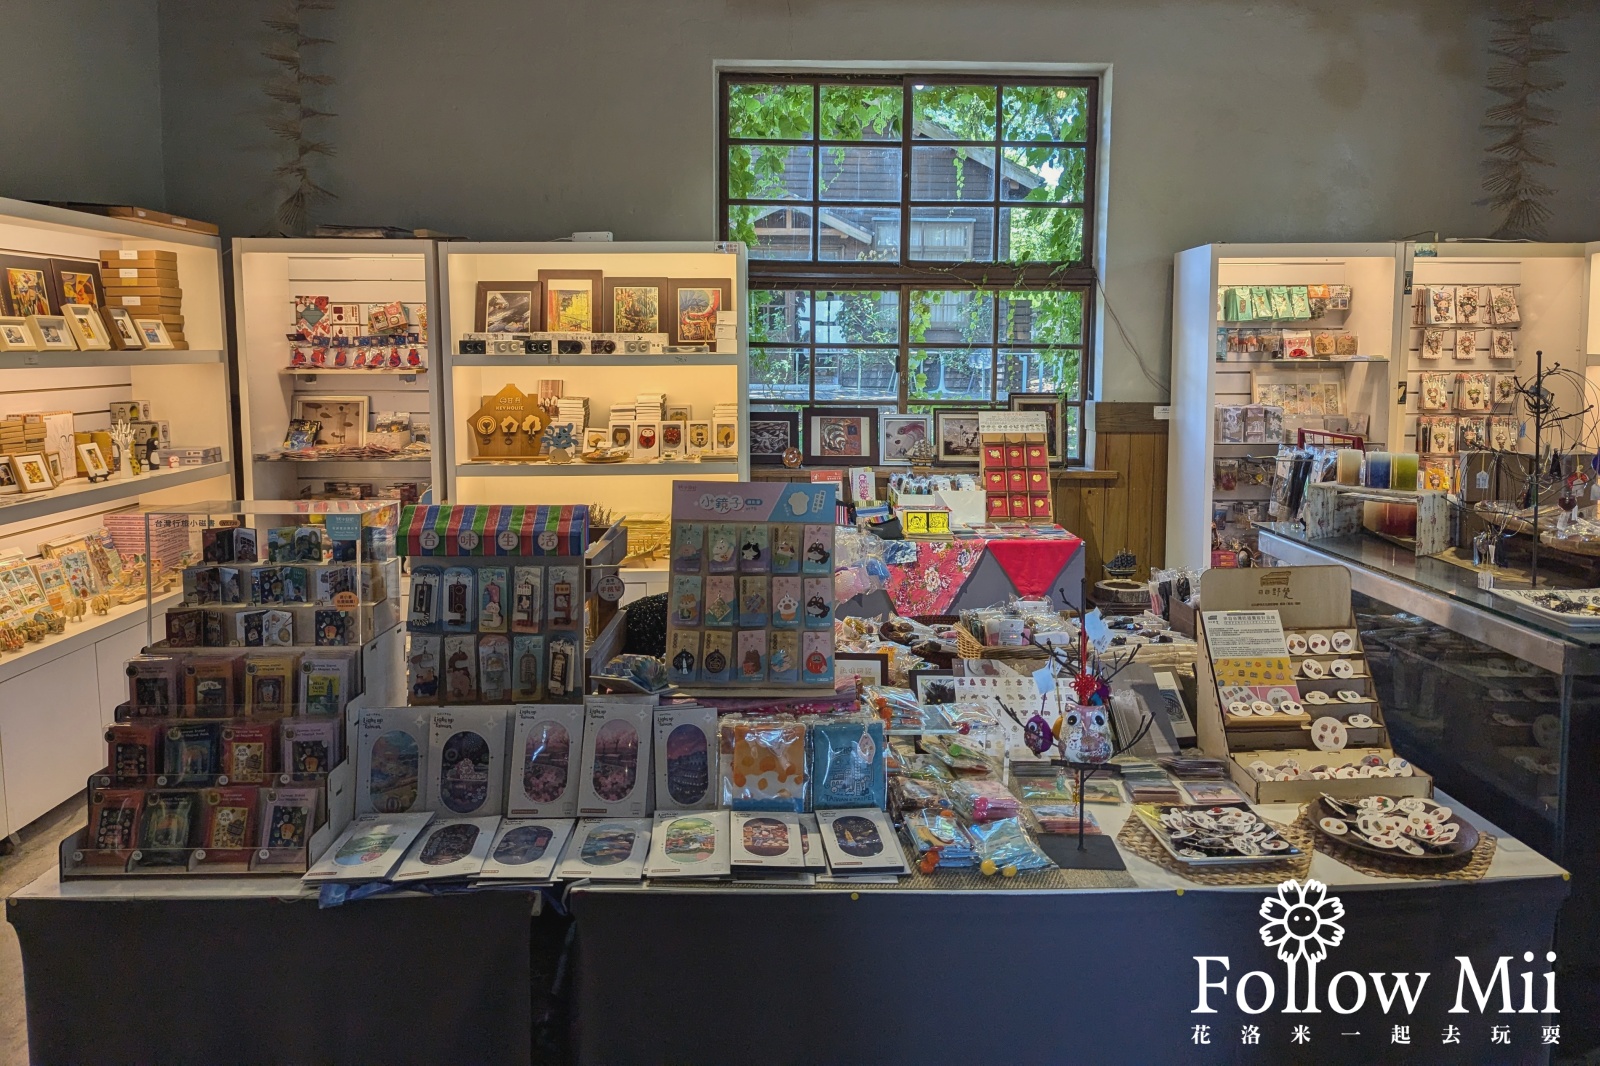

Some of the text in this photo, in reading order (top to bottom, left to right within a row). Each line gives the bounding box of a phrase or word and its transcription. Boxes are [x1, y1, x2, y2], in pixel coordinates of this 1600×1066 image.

[701, 496, 742, 512] 小鏡子
[423, 533, 556, 547] 台味生活
